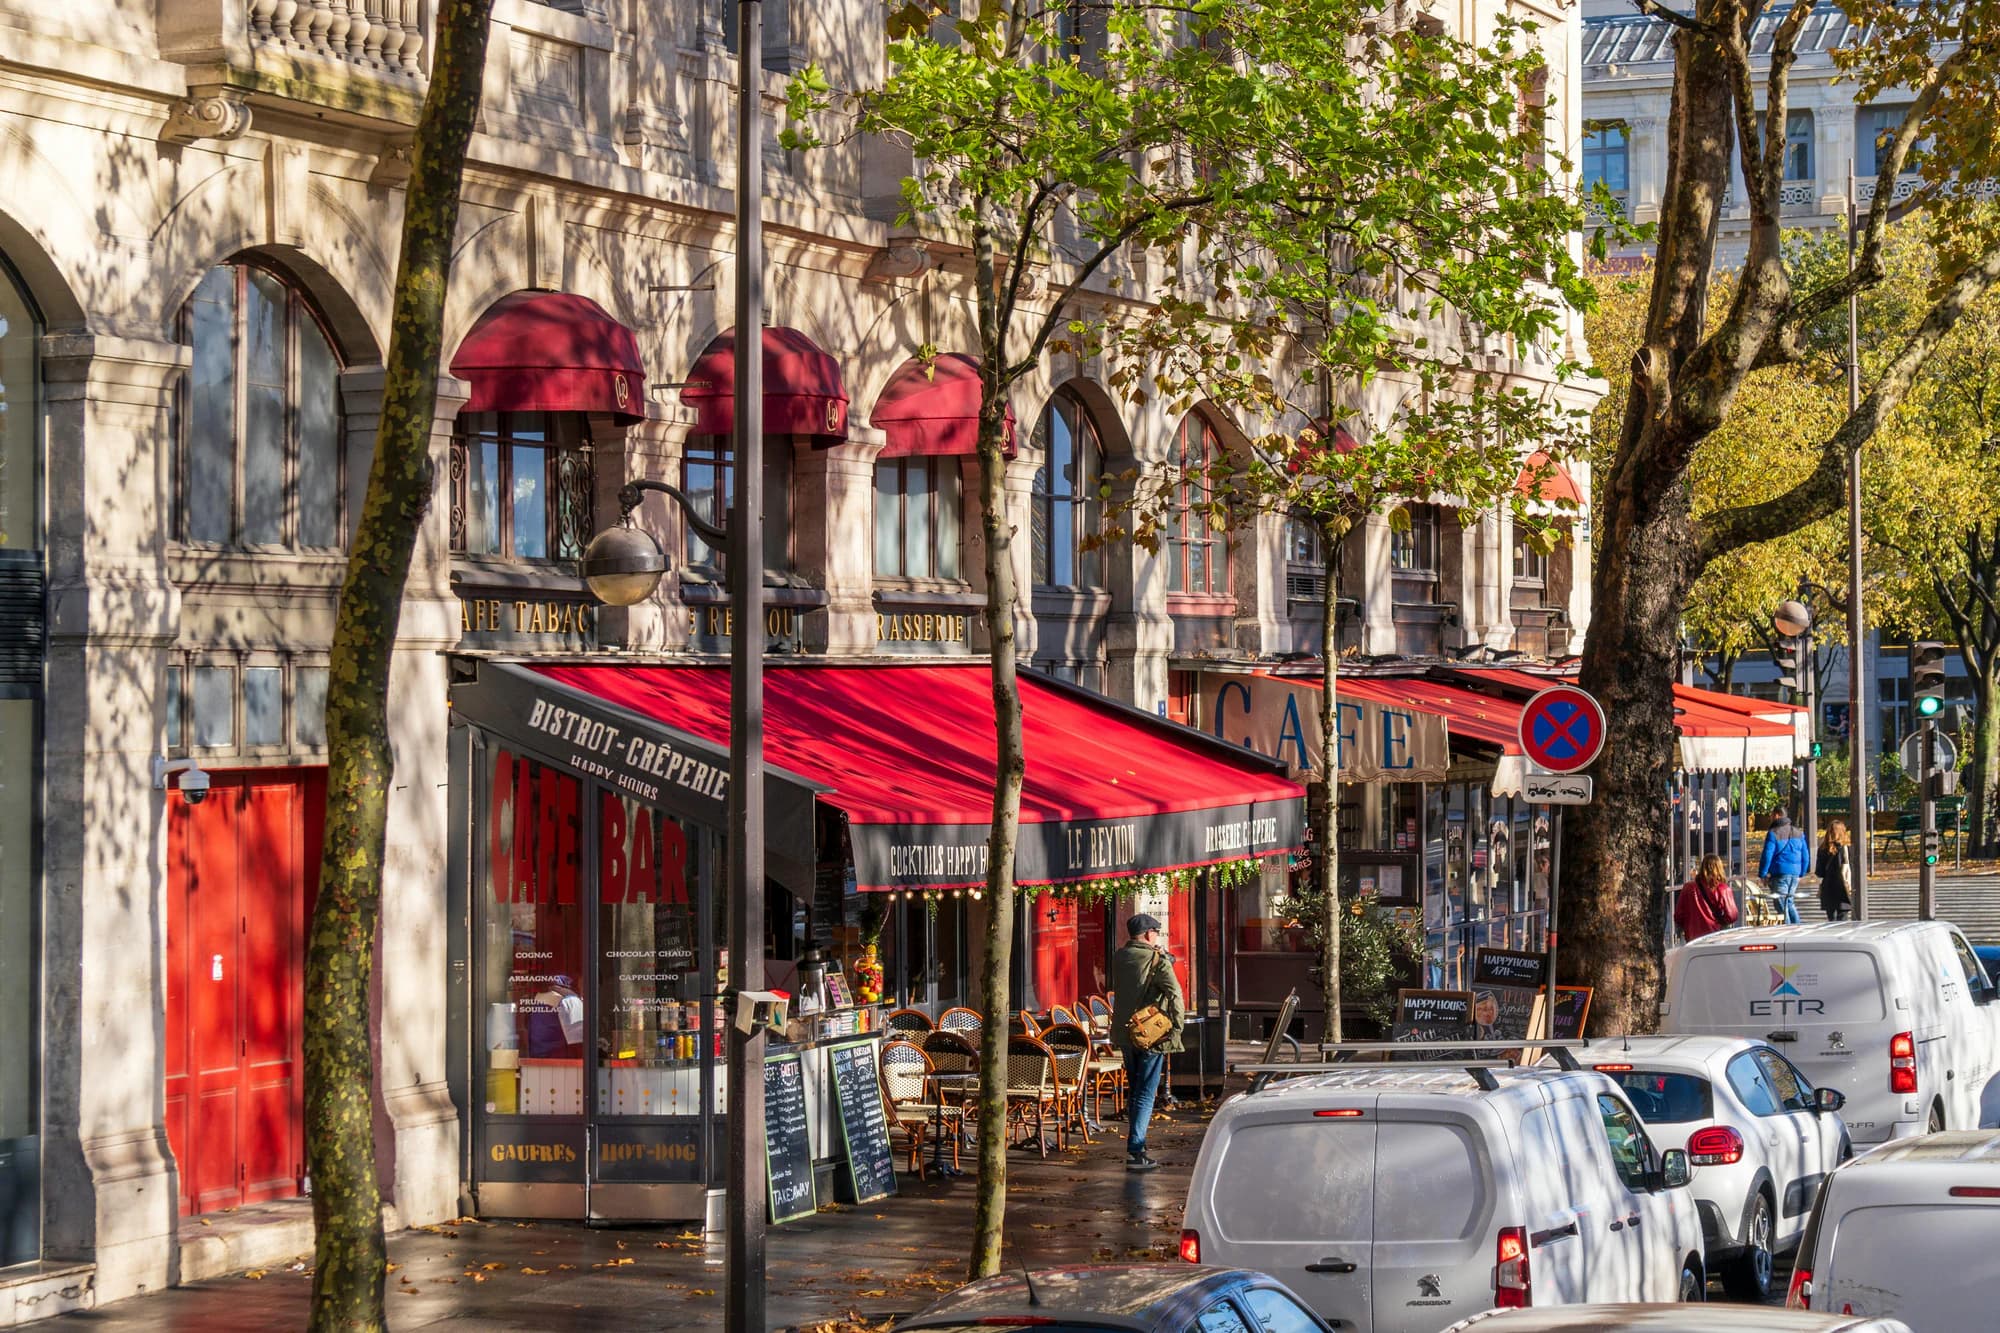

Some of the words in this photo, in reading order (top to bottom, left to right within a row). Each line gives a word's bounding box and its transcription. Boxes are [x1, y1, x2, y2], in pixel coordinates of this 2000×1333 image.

[461, 600, 500, 631] AFE
[514, 601, 590, 633] TABAC
[877, 614, 963, 641] RASSERIE
[1215, 680, 1414, 769] CAFE
[528, 698, 731, 801] BISTROT-CRÊPERIE
[570, 754, 614, 780] HAPPY
[618, 773, 659, 801] HOURS
[491, 751, 577, 904] CAFE
[602, 791, 688, 904] BAR
[1205, 822, 1242, 853] BRASSERIE
[890, 844, 944, 877] COCKTAILS
[947, 845, 977, 876] HAPPY
[1068, 828, 1083, 869] LE
[1090, 823, 1135, 867] REYNOU
[515, 951, 553, 959] COGNAC
[658, 950, 692, 958] CHAUD
[1484, 954, 1514, 966] HAPPY
[1513, 957, 1540, 970] HOURS
[1404, 998, 1436, 1009] HAPPY
[1436, 1000, 1468, 1011] HOURS
[1749, 999, 1825, 1016] ETR
[491, 1143, 577, 1163] GAUFRES
[601, 1143, 697, 1163] HOT-DOG
